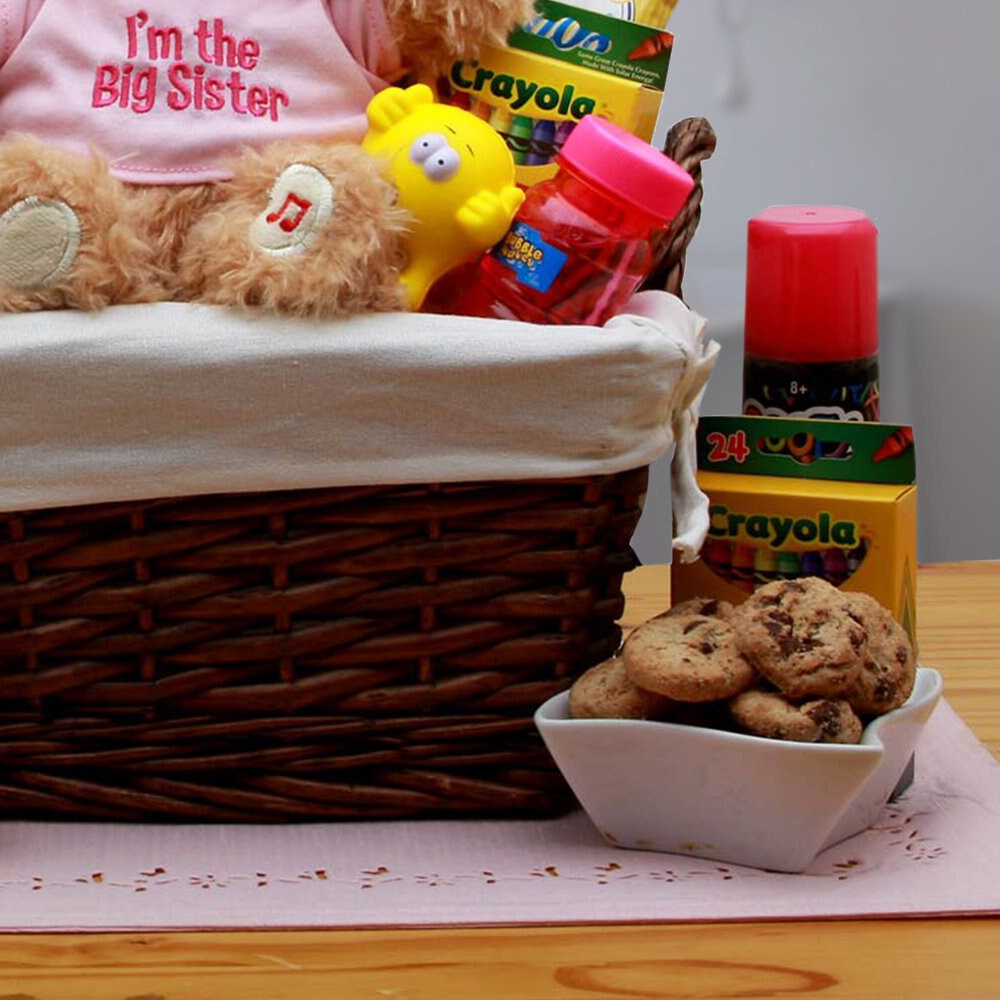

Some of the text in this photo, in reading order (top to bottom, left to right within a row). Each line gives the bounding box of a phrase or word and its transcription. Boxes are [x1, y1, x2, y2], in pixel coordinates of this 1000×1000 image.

[126, 9, 260, 70] I'm the
[92, 63, 289, 122] Big Sister
[451, 59, 597, 119] Crayola
[790, 381, 808, 395] 8+
[706, 430, 750, 463] 24
[708, 505, 858, 549] Crayola
